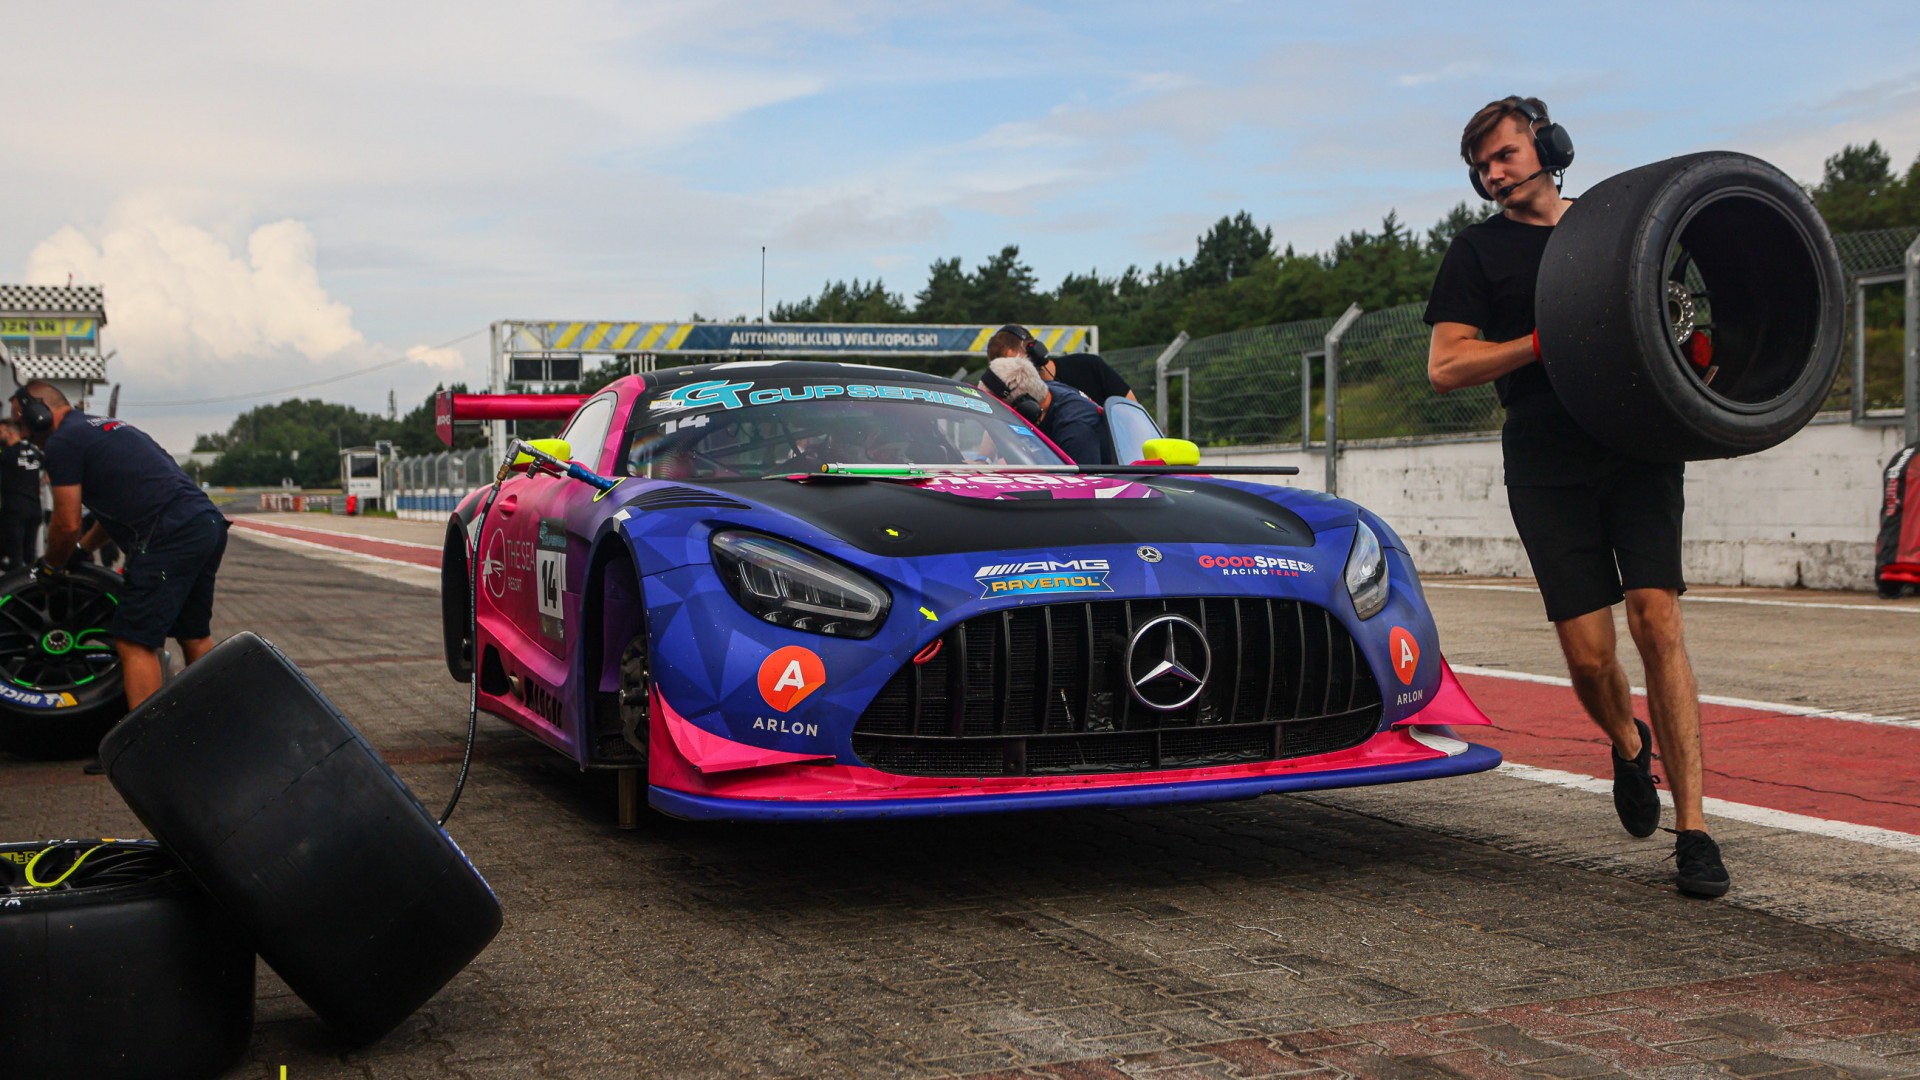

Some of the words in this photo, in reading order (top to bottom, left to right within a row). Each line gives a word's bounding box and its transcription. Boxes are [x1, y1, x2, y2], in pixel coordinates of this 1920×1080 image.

[730, 332, 841, 346] AUTOMOBILKLUB
[843, 333, 938, 346] WIELKOPOLSKI
[668, 379, 755, 410] GT
[748, 385, 844, 405] CUP
[846, 384, 993, 415] SERIES
[660, 414, 710, 435] 14
[1012, 559, 1110, 574] AMG
[541, 559, 558, 609] 14
[991, 576, 1101, 592] RAVENOL
[773, 659, 805, 692] A
[1396, 689, 1423, 706] ARLON
[752, 716, 818, 737] ARLON
